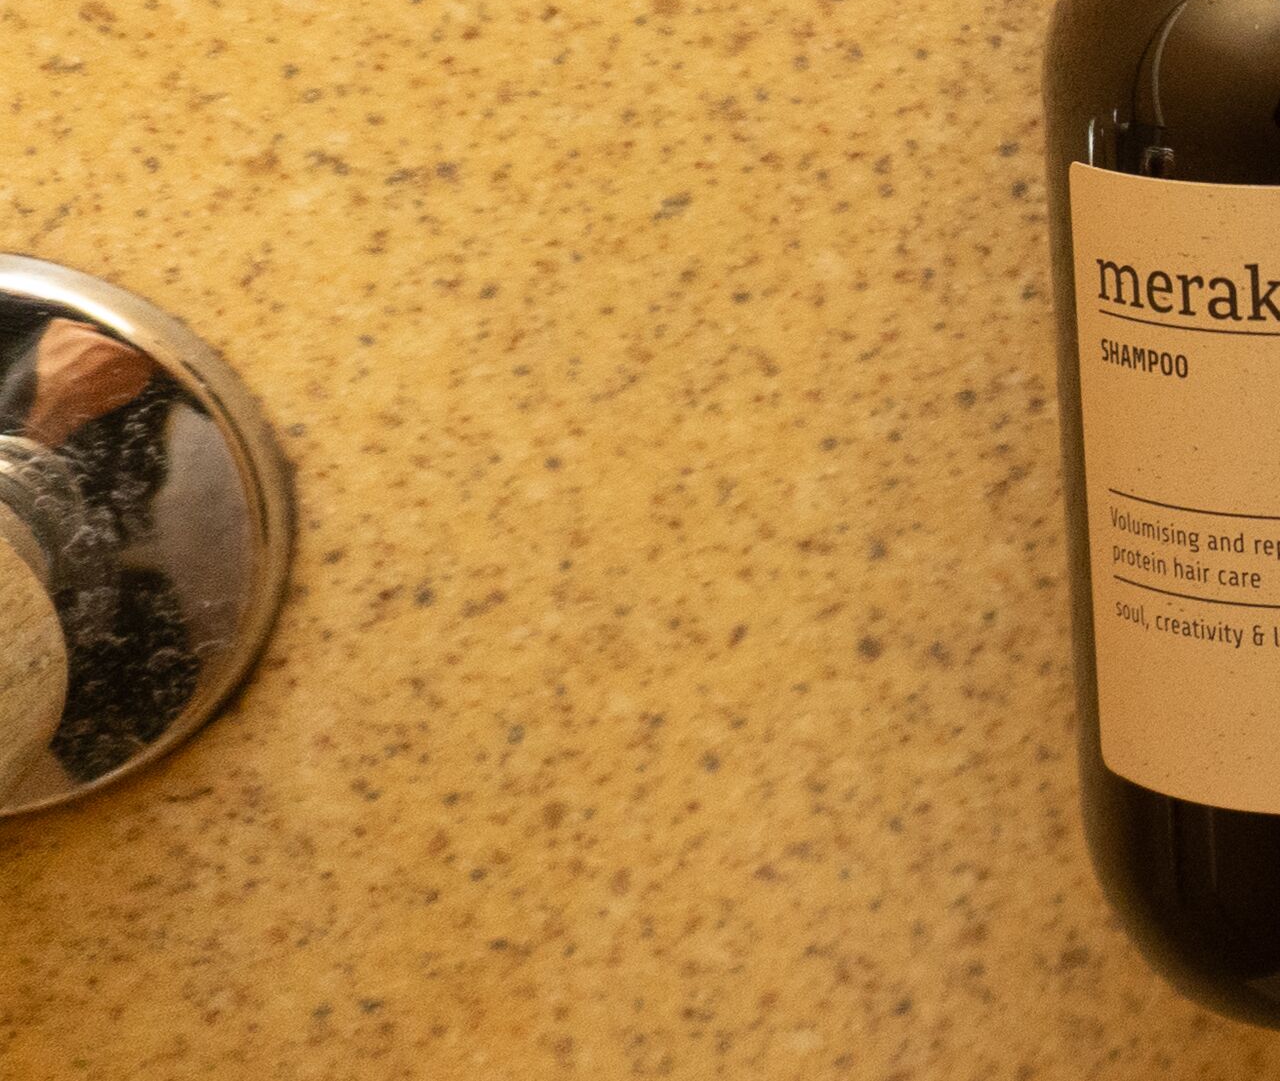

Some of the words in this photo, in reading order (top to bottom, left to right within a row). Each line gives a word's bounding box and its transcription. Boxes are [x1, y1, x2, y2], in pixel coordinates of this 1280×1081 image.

[1101, 338, 1189, 378] SHAMPOO
[1110, 506, 1200, 553] Volumising
[1207, 533, 1245, 553] and
[1112, 545, 1167, 575] protein
[1173, 557, 1210, 583] hair
[1218, 568, 1262, 588] care
[1115, 601, 1149, 631] soul,
[1155, 614, 1244, 649] creativity
[1252, 625, 1265, 646] &
